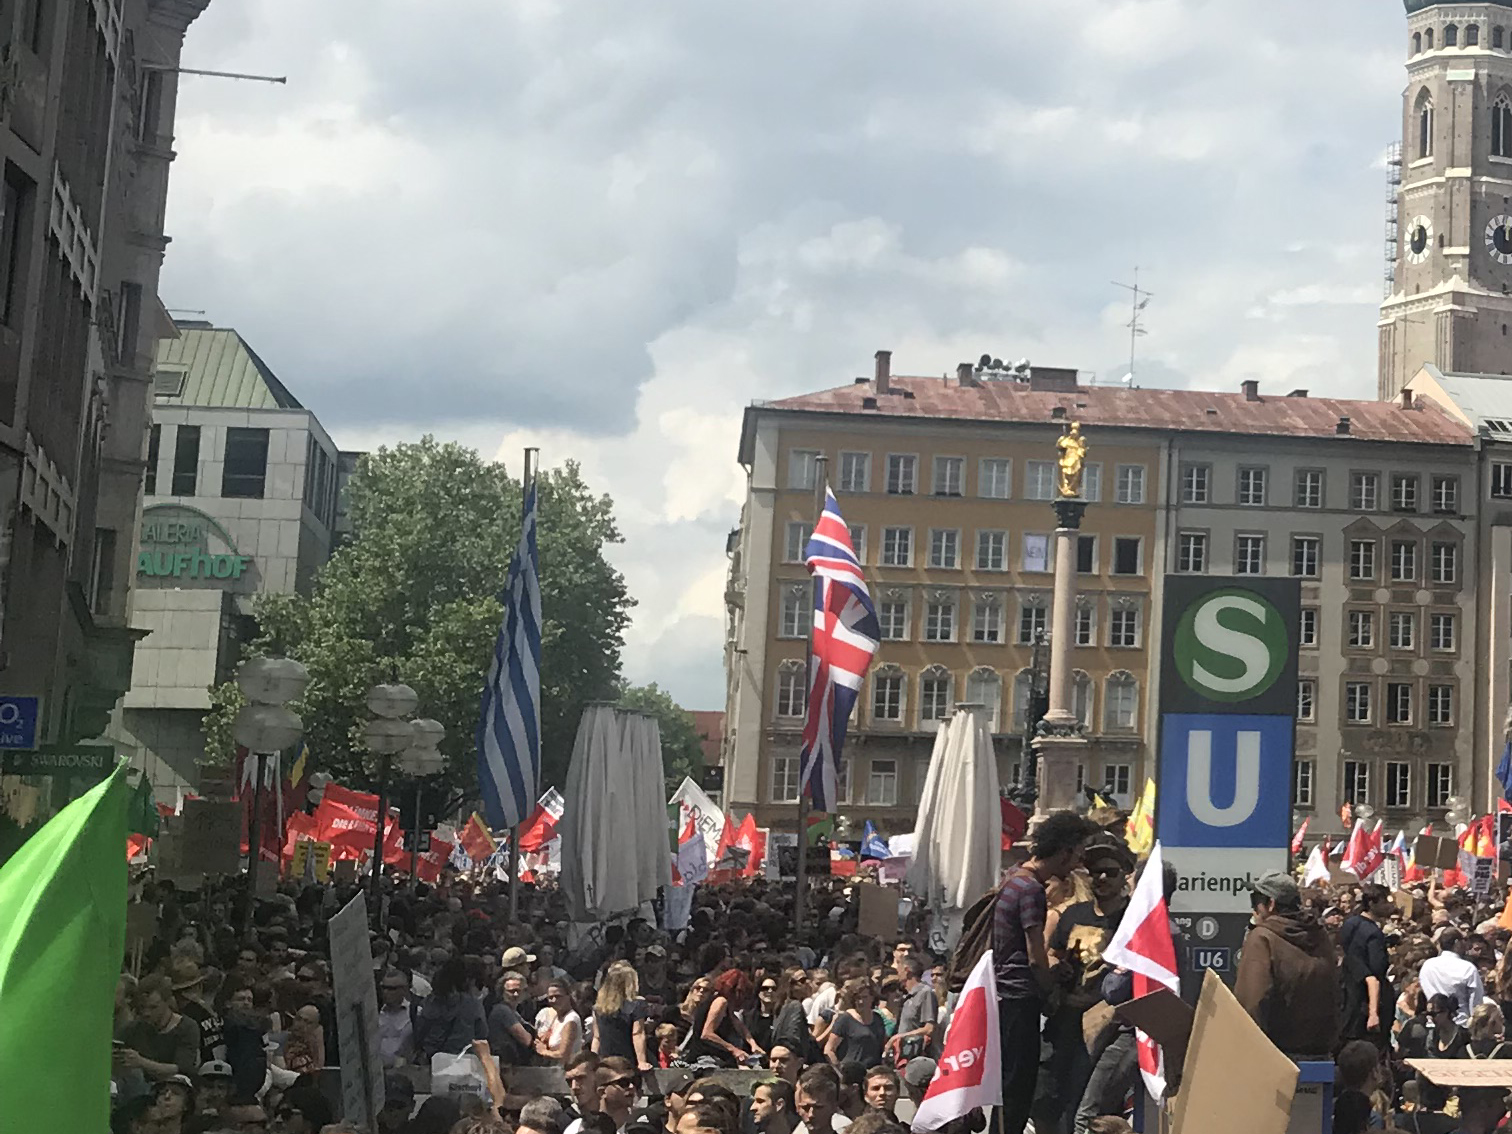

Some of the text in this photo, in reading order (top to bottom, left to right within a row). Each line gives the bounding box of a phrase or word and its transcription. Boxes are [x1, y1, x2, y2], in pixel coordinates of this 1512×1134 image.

[141, 522, 202, 542] ALERIA
[137, 546, 252, 578] AUFhOF
[1192, 595, 1271, 693] S
[1, 733, 24, 744] ive
[30, 754, 104, 768] SWAROVSKI
[1186, 730, 1260, 828] U
[1178, 872, 1259, 897] arienpl
[1202, 920, 1215, 936] D
[1199, 951, 1224, 967] U6
